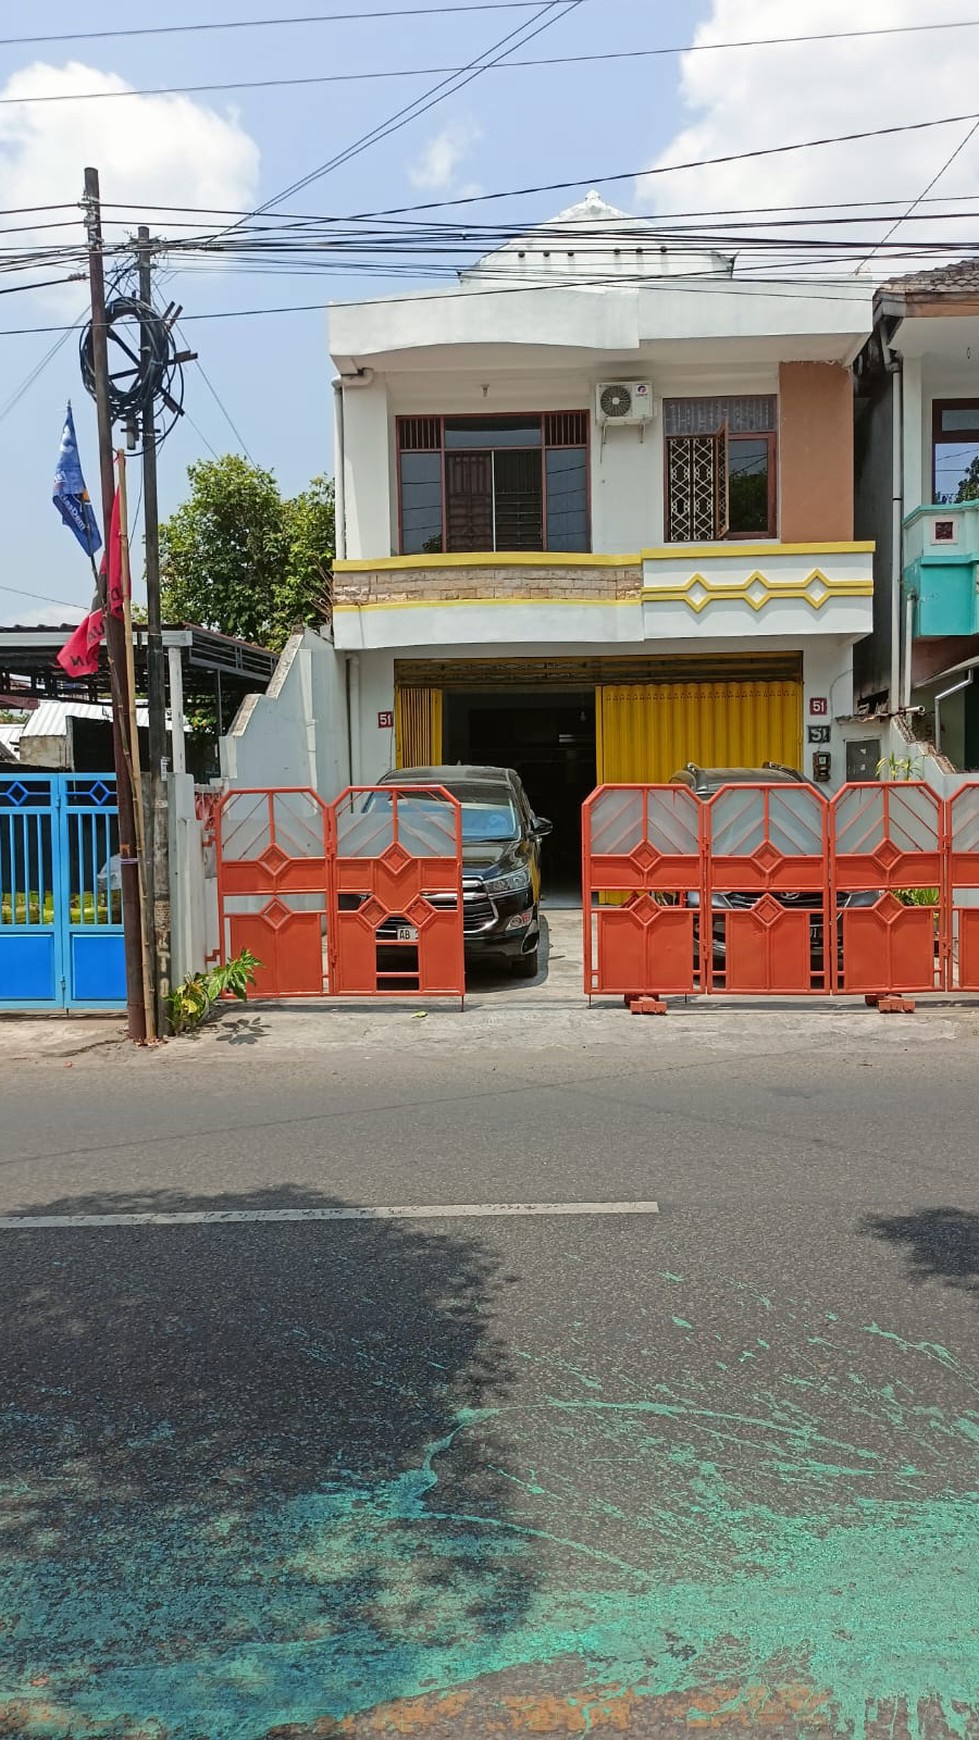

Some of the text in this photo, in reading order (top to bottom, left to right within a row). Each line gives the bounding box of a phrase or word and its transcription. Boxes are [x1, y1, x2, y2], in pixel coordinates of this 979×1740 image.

[812, 700, 825, 712] 51
[380, 714, 391, 725] 51
[811, 728, 828, 742] 51
[400, 929, 411, 939] AB
